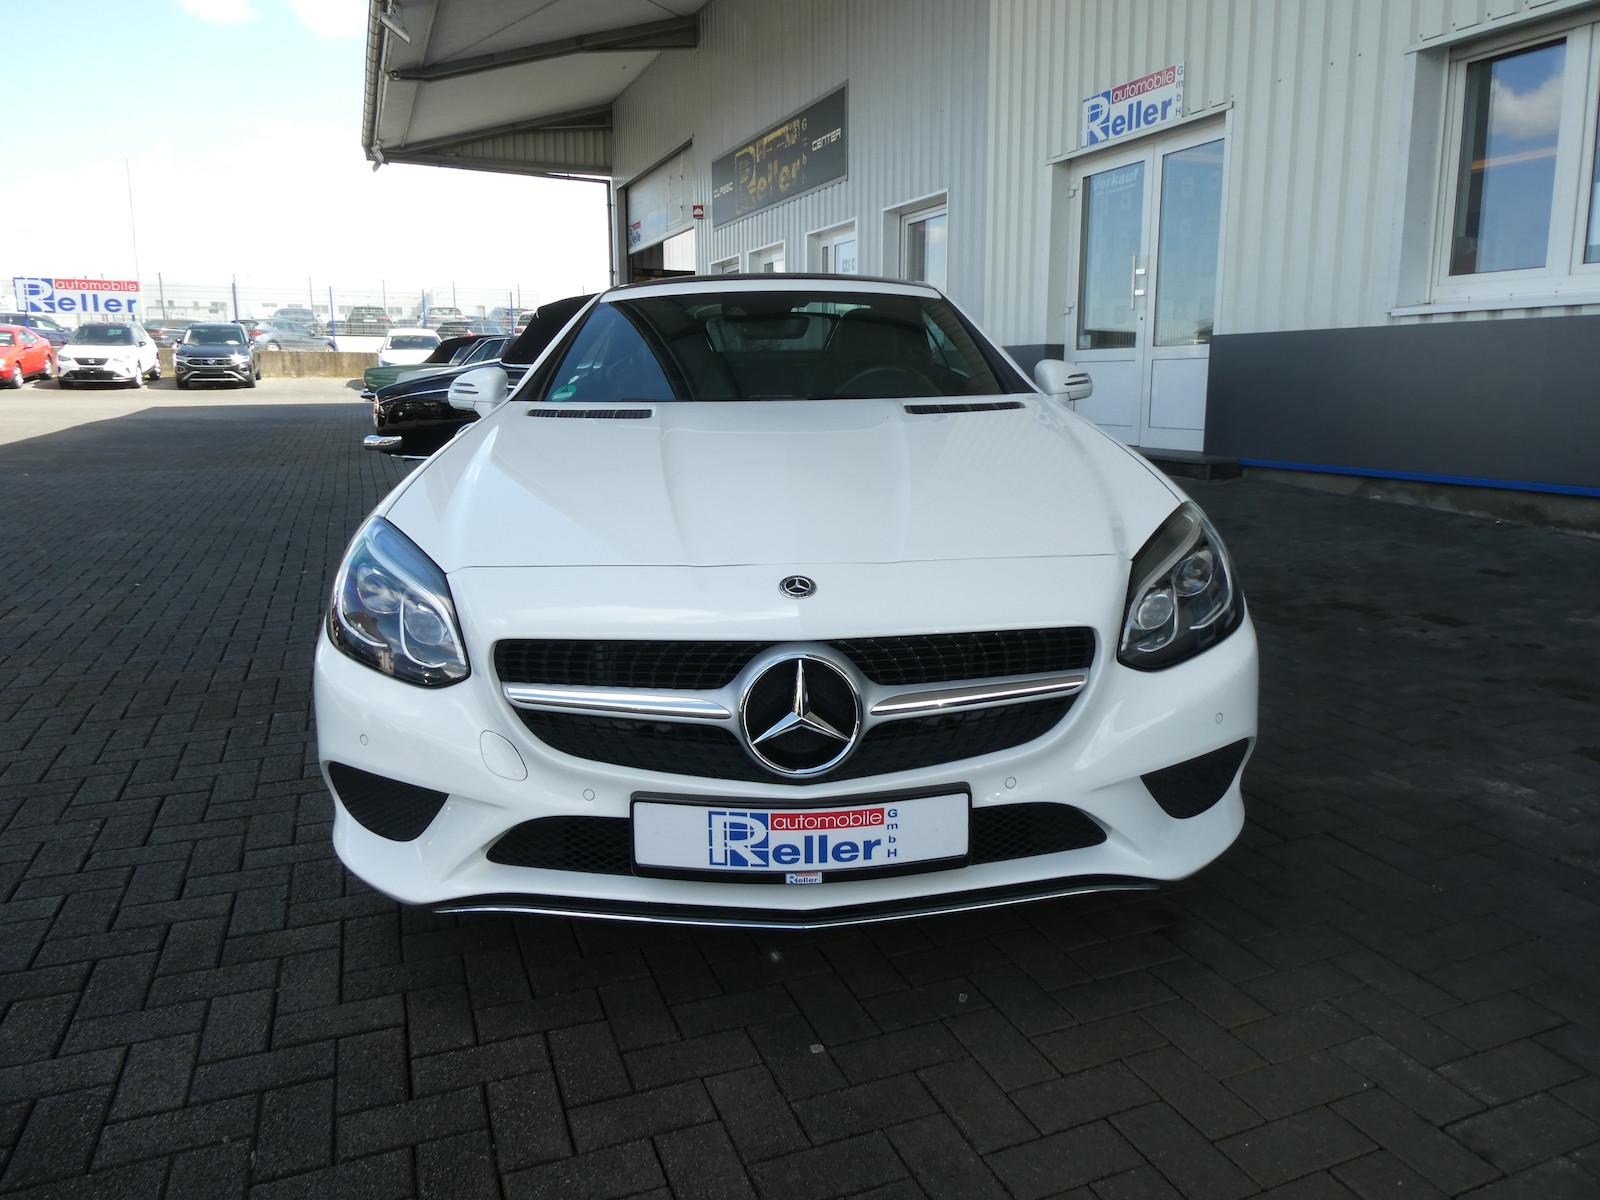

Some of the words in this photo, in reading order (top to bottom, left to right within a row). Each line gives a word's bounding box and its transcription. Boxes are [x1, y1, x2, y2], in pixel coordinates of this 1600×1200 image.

[1112, 70, 1175, 103] automobile
[1081, 90, 1173, 147] Reller
[811, 127, 842, 152] CENTER
[13, 277, 137, 313] Reller
[55, 280, 137, 291] automobile
[773, 812, 883, 830] automobile
[886, 808, 899, 858] GmbH
[708, 811, 882, 867] Reller
